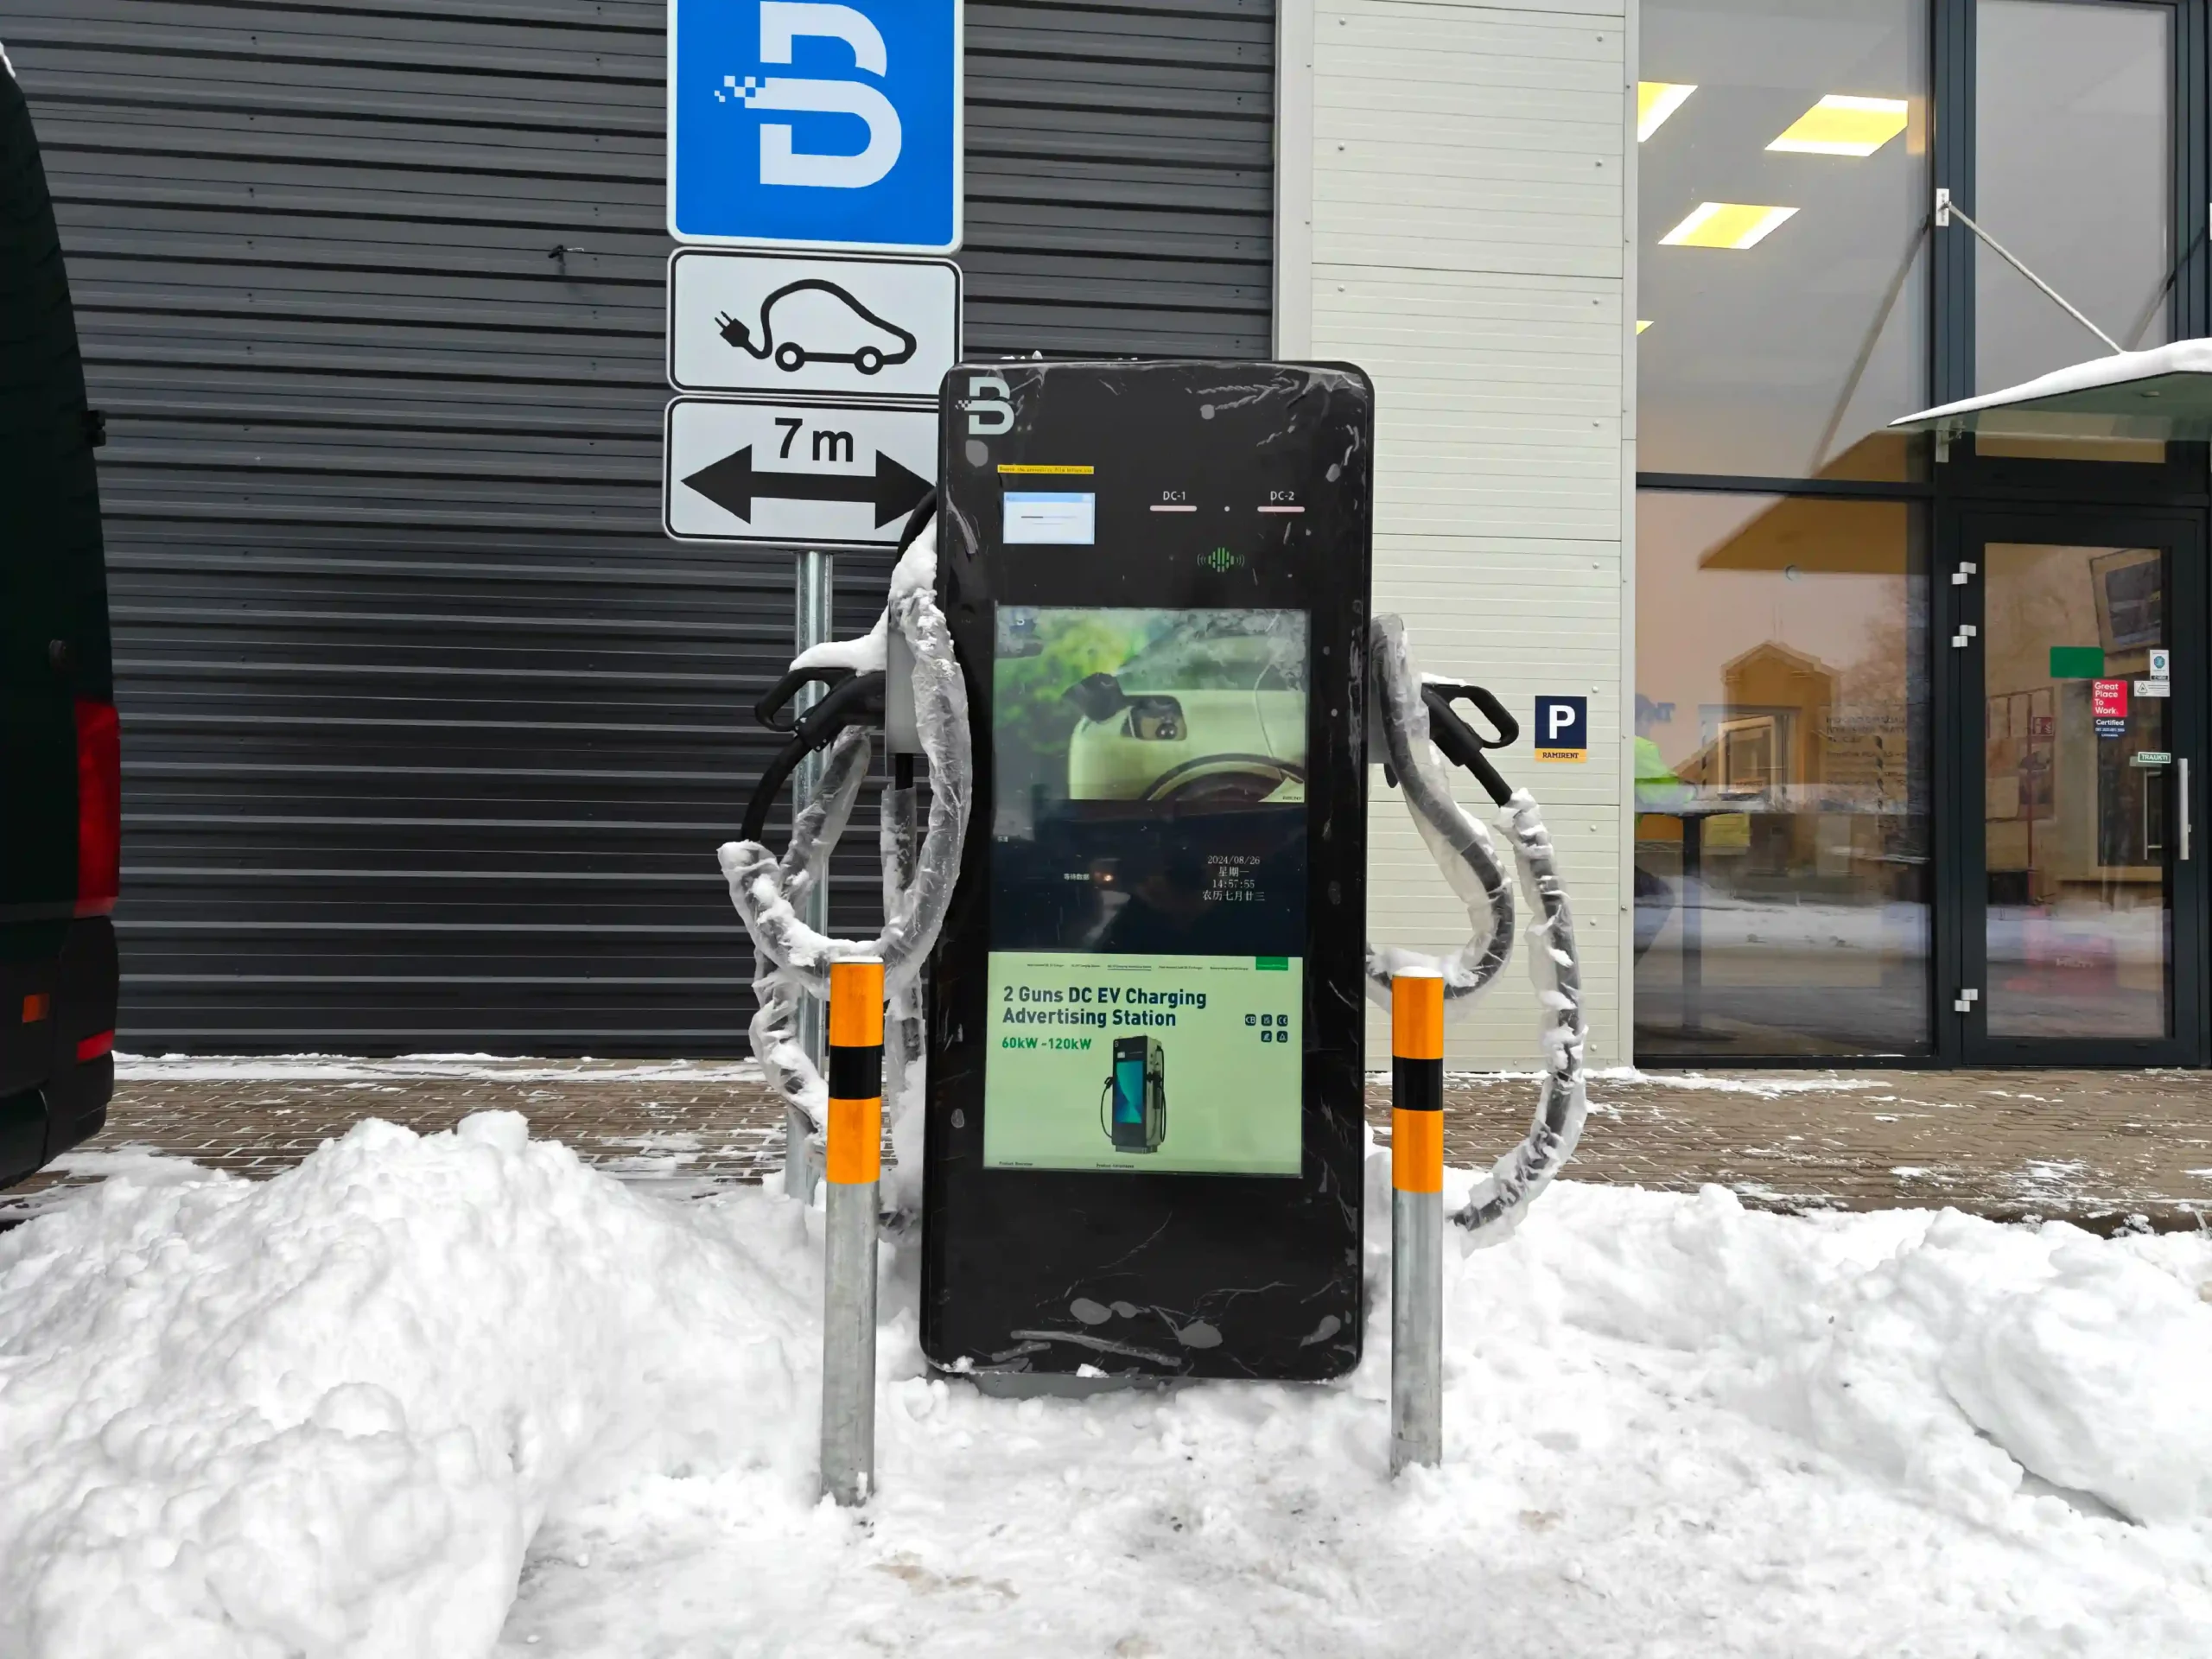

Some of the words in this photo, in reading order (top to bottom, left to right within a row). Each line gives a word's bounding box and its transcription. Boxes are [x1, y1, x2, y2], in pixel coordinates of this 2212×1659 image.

[774, 416, 804, 459] 7
[812, 430, 854, 462] m
[1162, 491, 1186, 501] DC-1
[1269, 491, 1295, 501] DC-2
[1548, 704, 1576, 740] P
[1207, 855, 1261, 865] 2024/08/26
[1218, 866, 1249, 877] 星期一
[1212, 879, 1255, 888] 14:57:55
[1202, 889, 1266, 901] 农历七月廿三
[1003, 986, 1014, 1002] 2
[1019, 986, 1064, 1002] Guns
[1069, 987, 1092, 1003] DC
[1097, 988, 1121, 1004] EV
[1126, 988, 1206, 1009] Charging
[1002, 1007, 1107, 1028] Advertising
[1113, 1009, 1176, 1027] Station
[1001, 1037, 1038, 1049] 60kW
